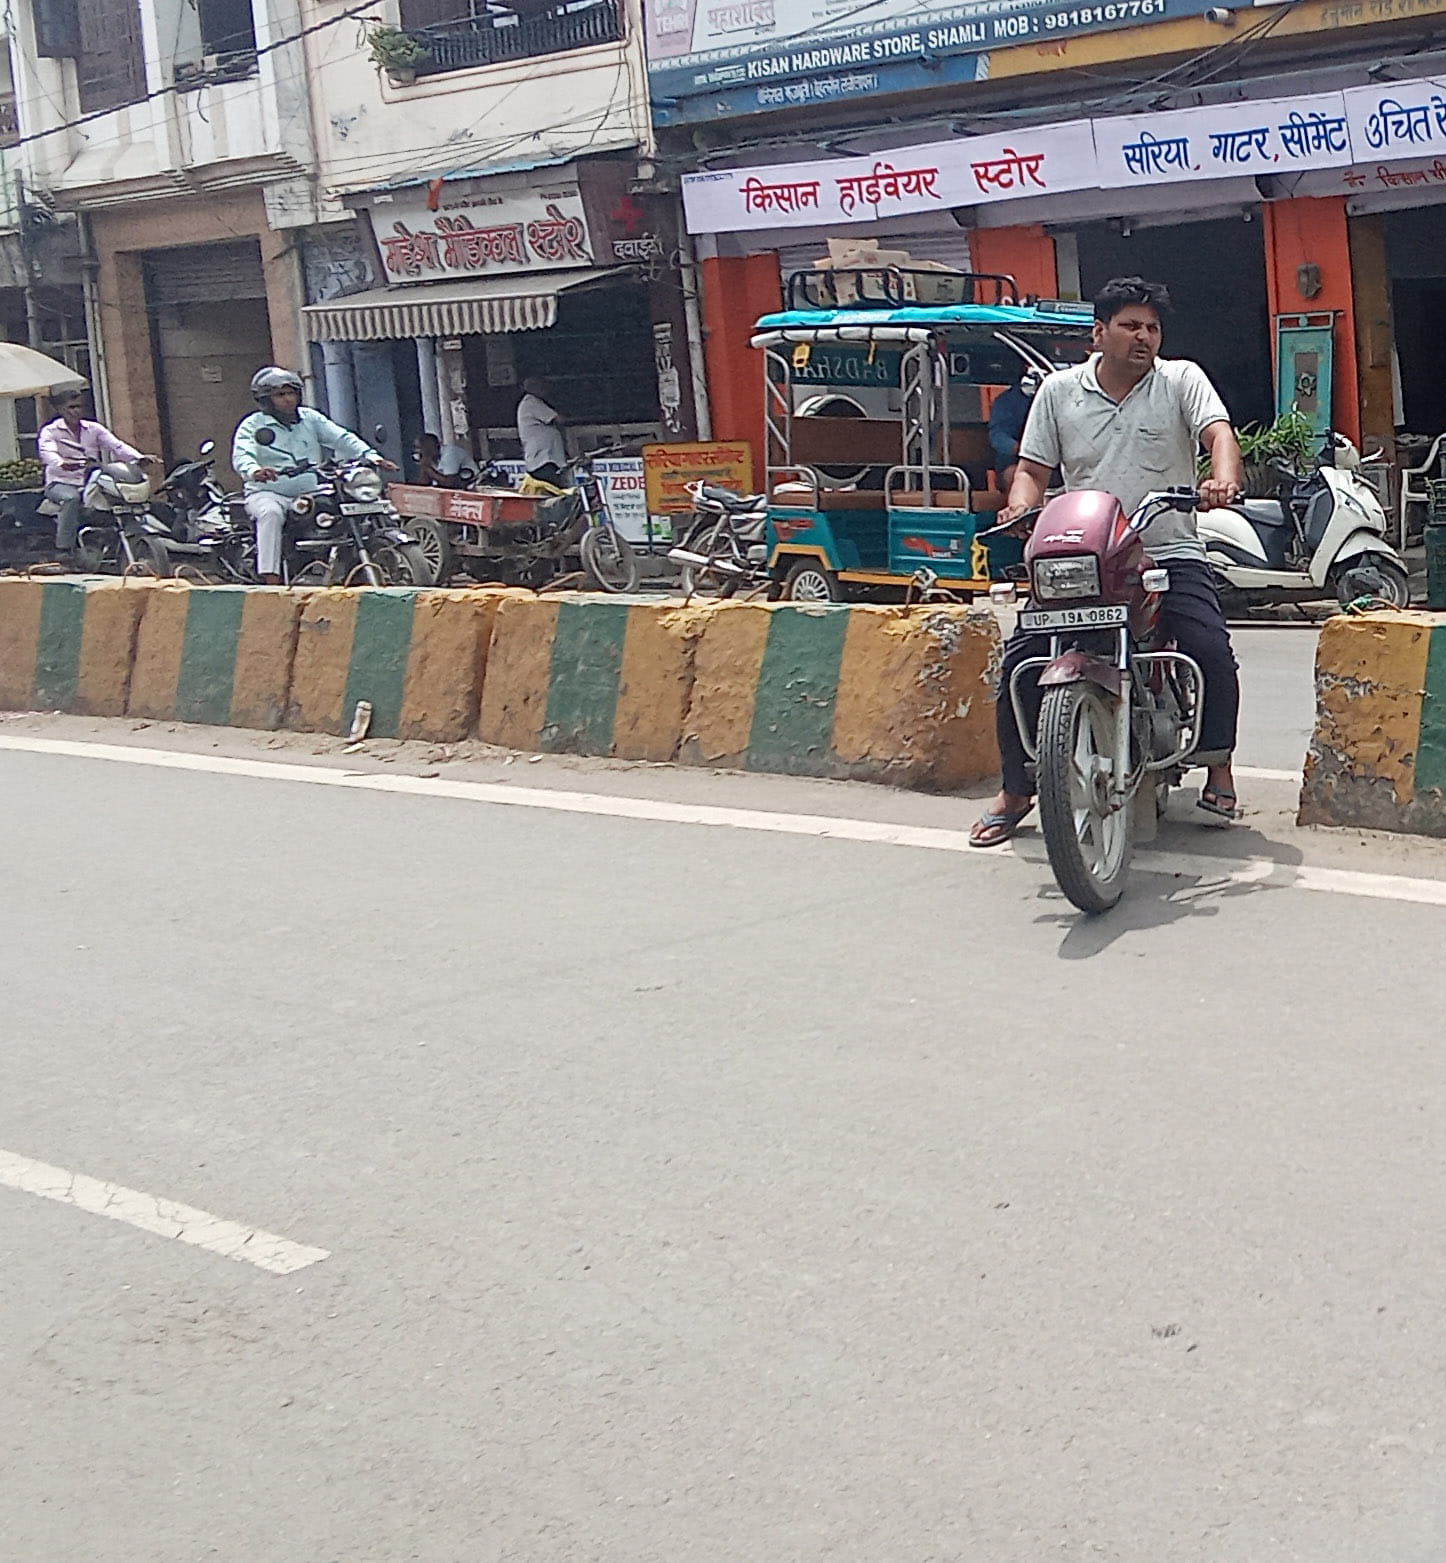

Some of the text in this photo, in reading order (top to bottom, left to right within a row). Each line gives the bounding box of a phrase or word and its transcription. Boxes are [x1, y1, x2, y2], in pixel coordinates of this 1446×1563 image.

[747, 57, 790, 79] KISAN
[792, 45, 871, 72] HARDWARE
[872, 33, 925, 58] STORE,
[928, 22, 985, 49] SHAMLI
[1045, 1, 1165, 30] 9818167761
[1279, 110, 1348, 158] सीमेंट
[1364, 99, 1432, 149] उचित
[739, 177, 819, 214] किसान
[970, 148, 1046, 194] स्टोर
[528, 204, 586, 260] स्टोर
[1033, 608, 1123, 627] UP 19A 0862
